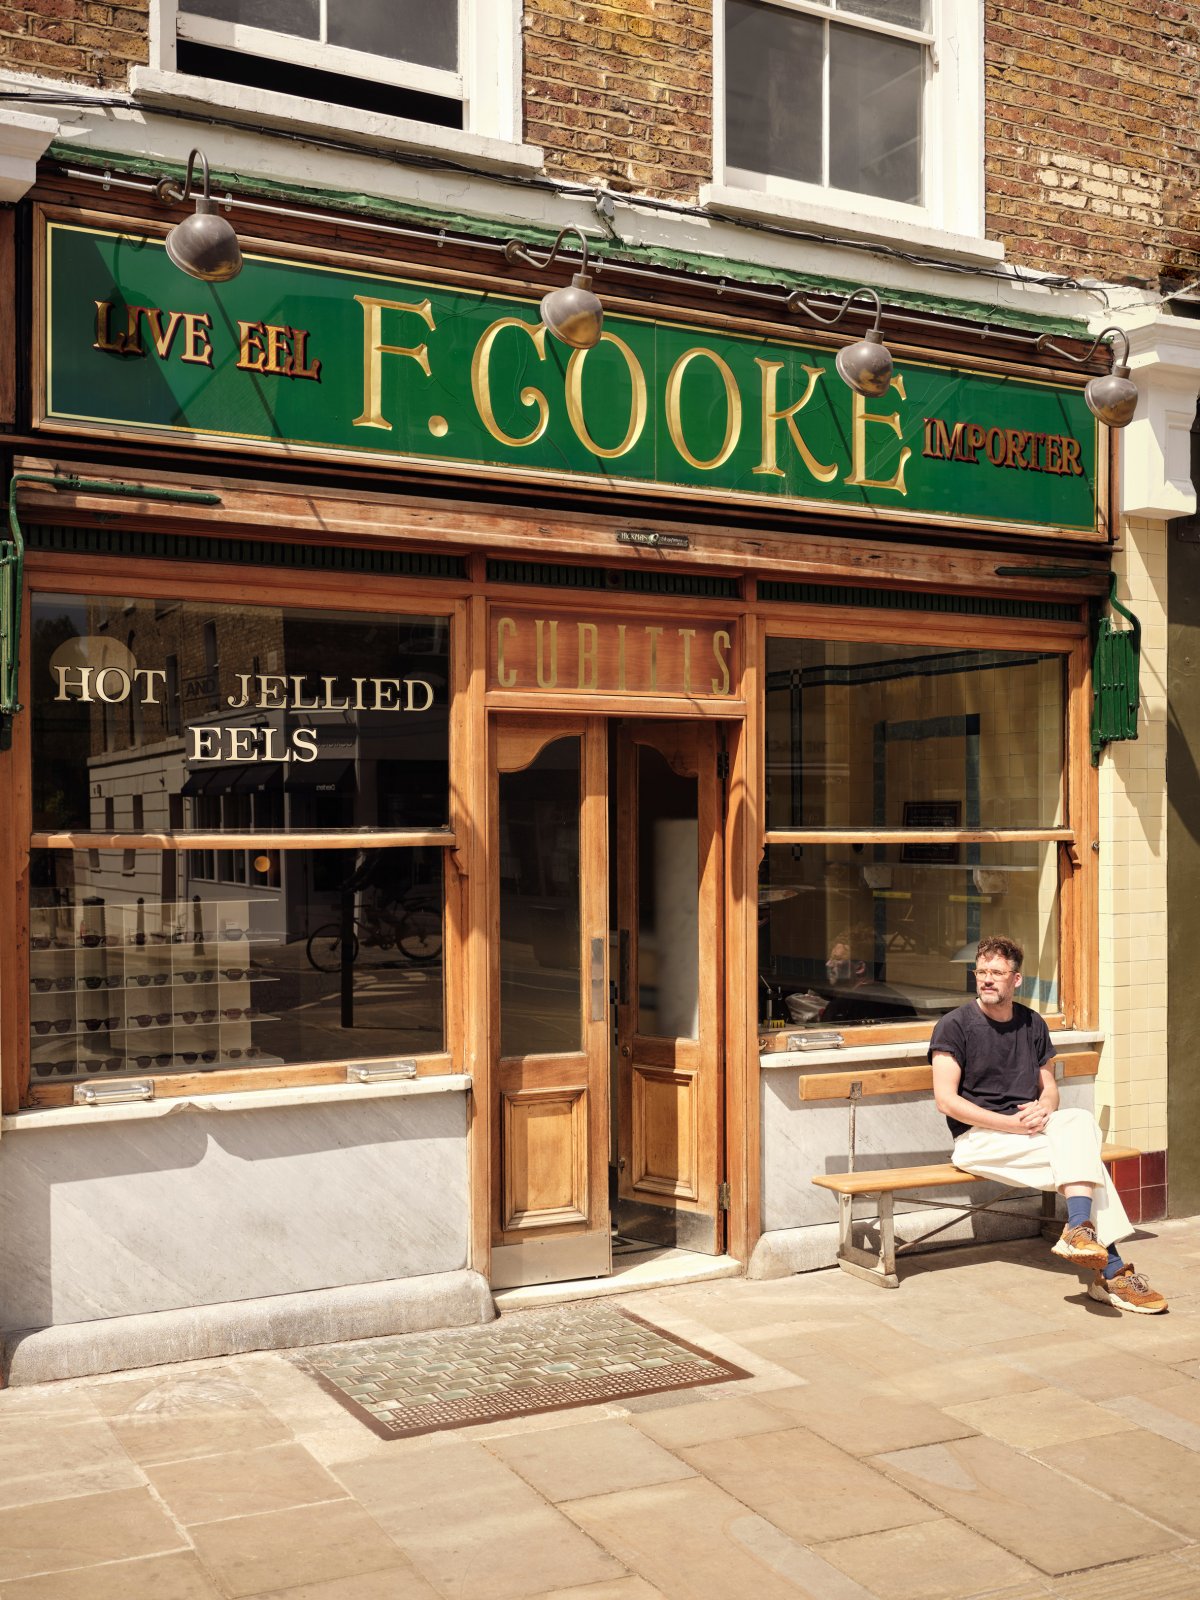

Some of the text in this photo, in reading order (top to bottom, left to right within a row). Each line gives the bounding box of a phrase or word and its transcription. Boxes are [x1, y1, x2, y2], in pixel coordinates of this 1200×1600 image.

[93, 300, 321, 382] LIVE EEL
[922, 416, 1084, 477] IMPORTER
[497, 617, 731, 695] CUBITTS
[53, 665, 167, 704] HOT
[227, 673, 435, 712] JELLIED
[188, 726, 319, 762] EELS
